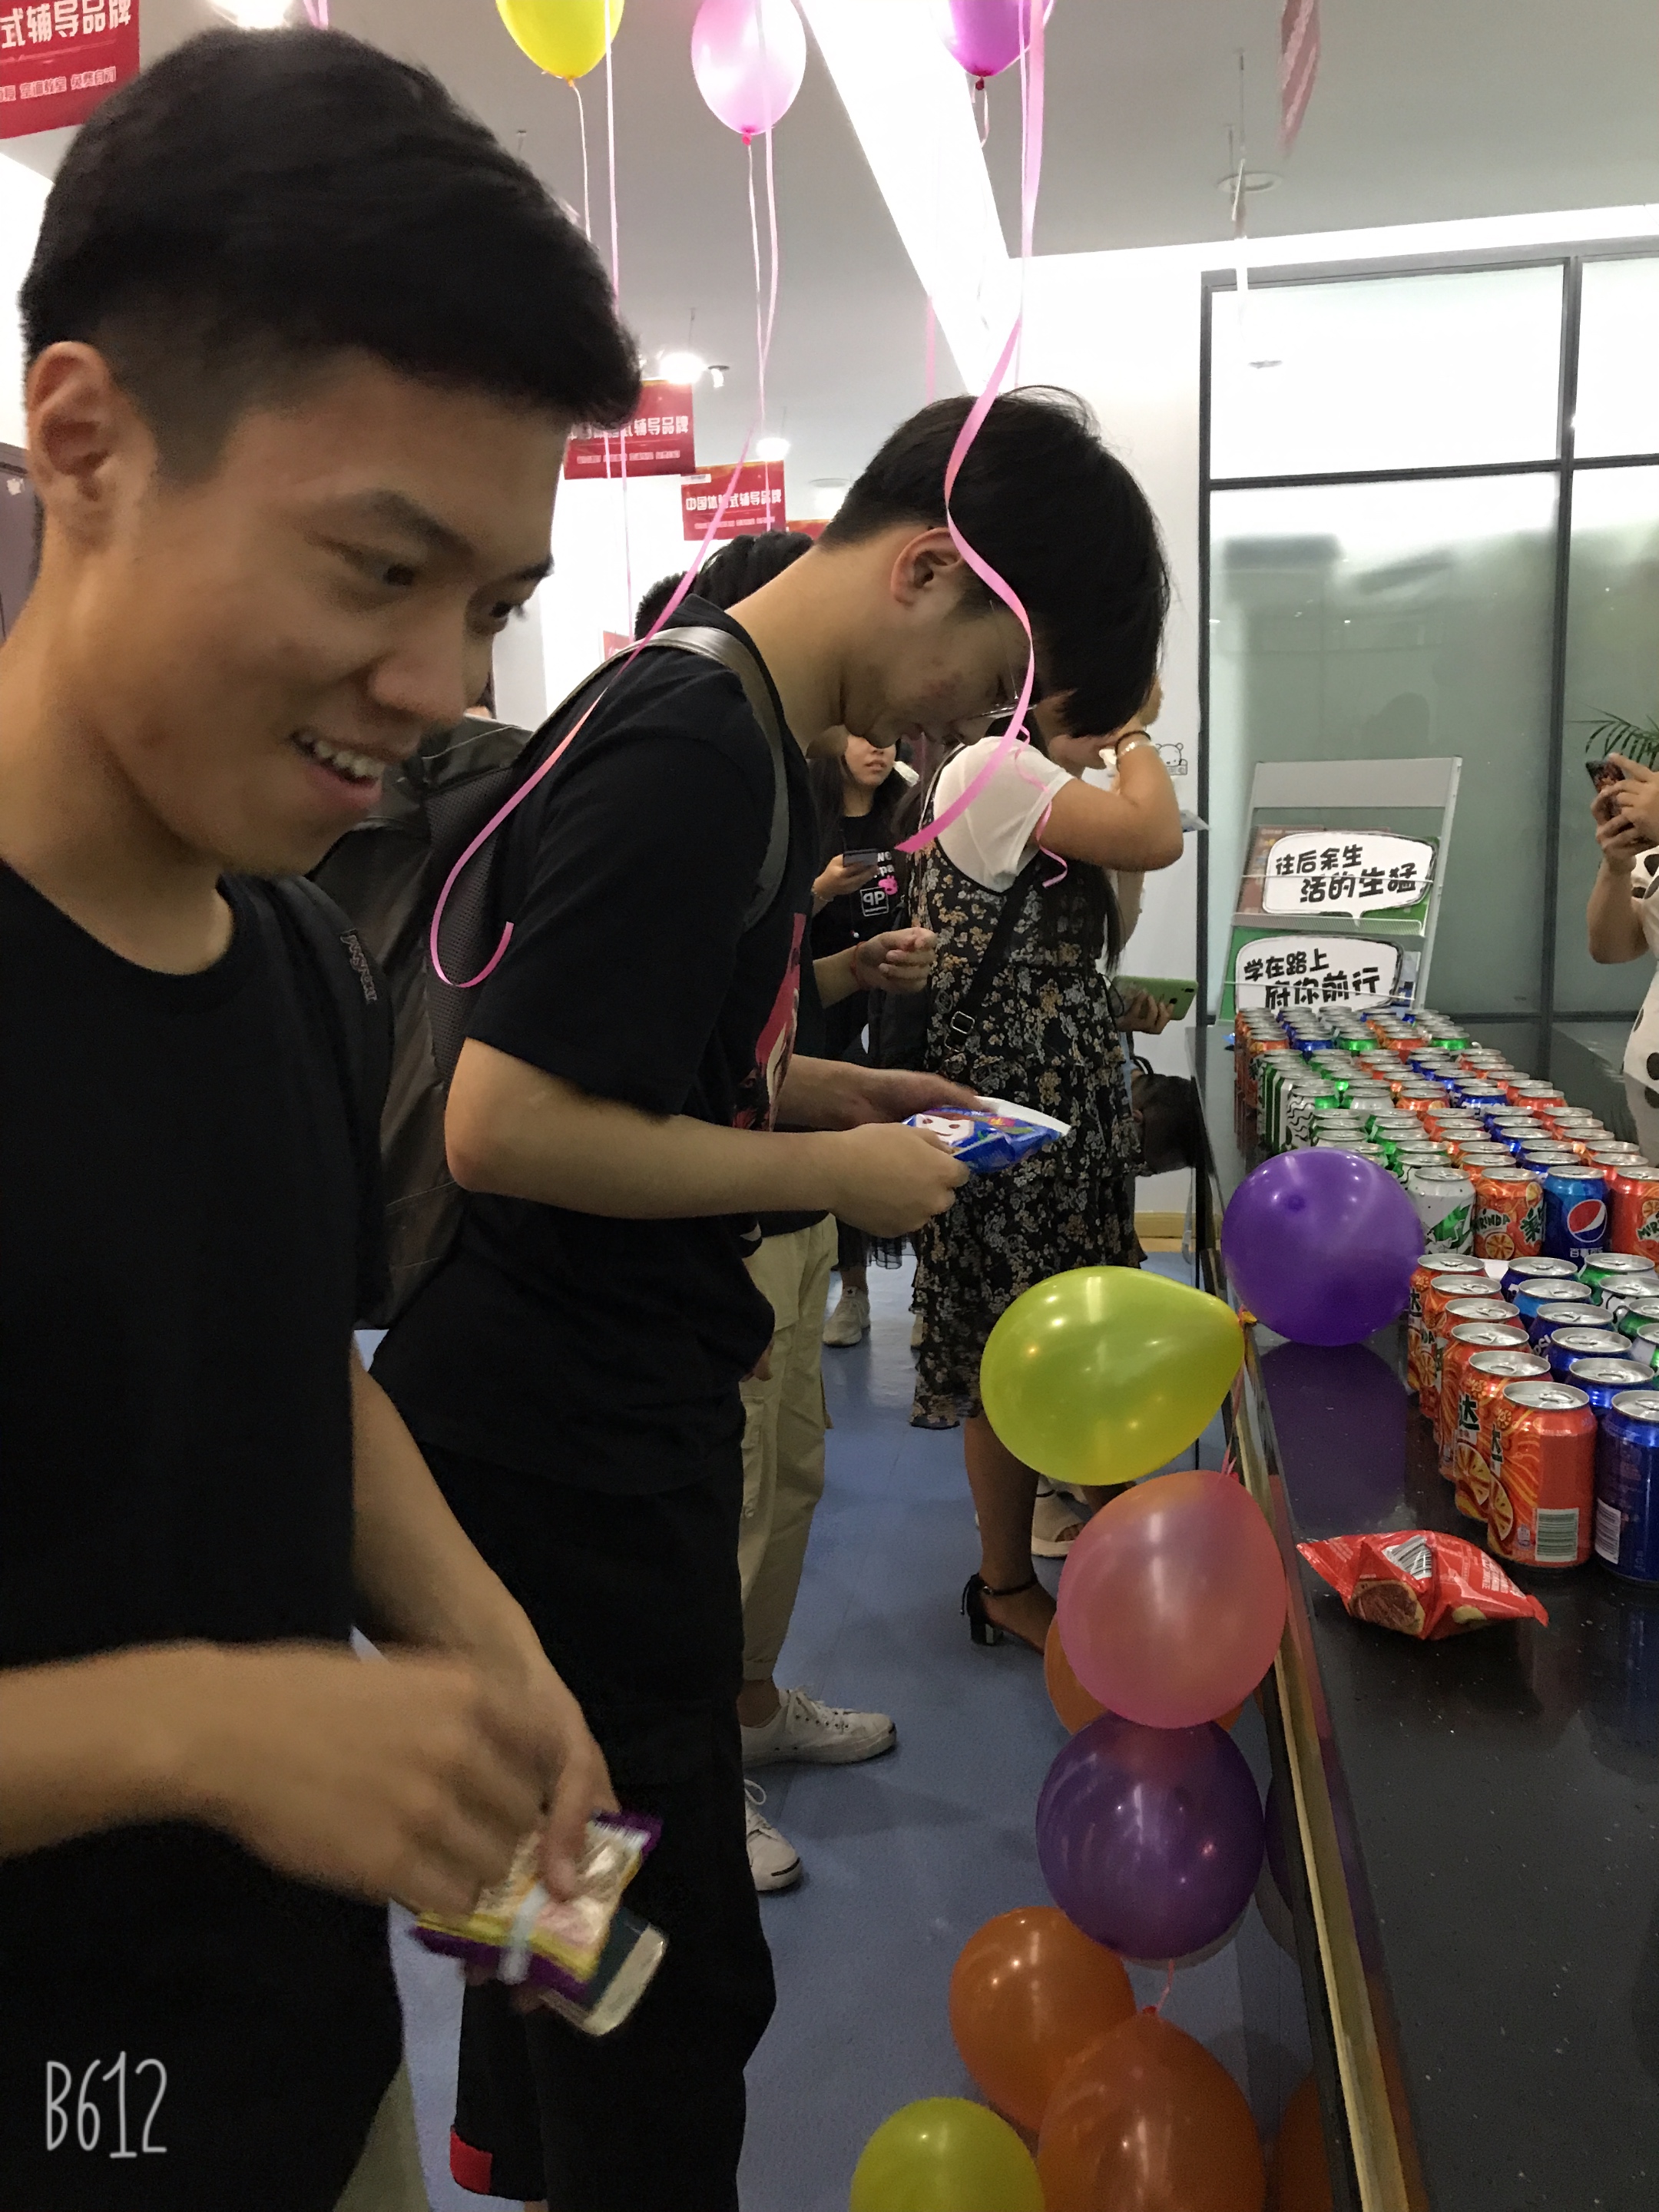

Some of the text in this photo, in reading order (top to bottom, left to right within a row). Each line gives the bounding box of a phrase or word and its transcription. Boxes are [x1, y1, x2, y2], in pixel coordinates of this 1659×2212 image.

[0, 0, 131, 48] 式辅导品牌
[1276, 844, 1363, 876] 往后余生
[1300, 863, 1417, 902] 活的生猛
[1243, 949, 1330, 982] 学在路上
